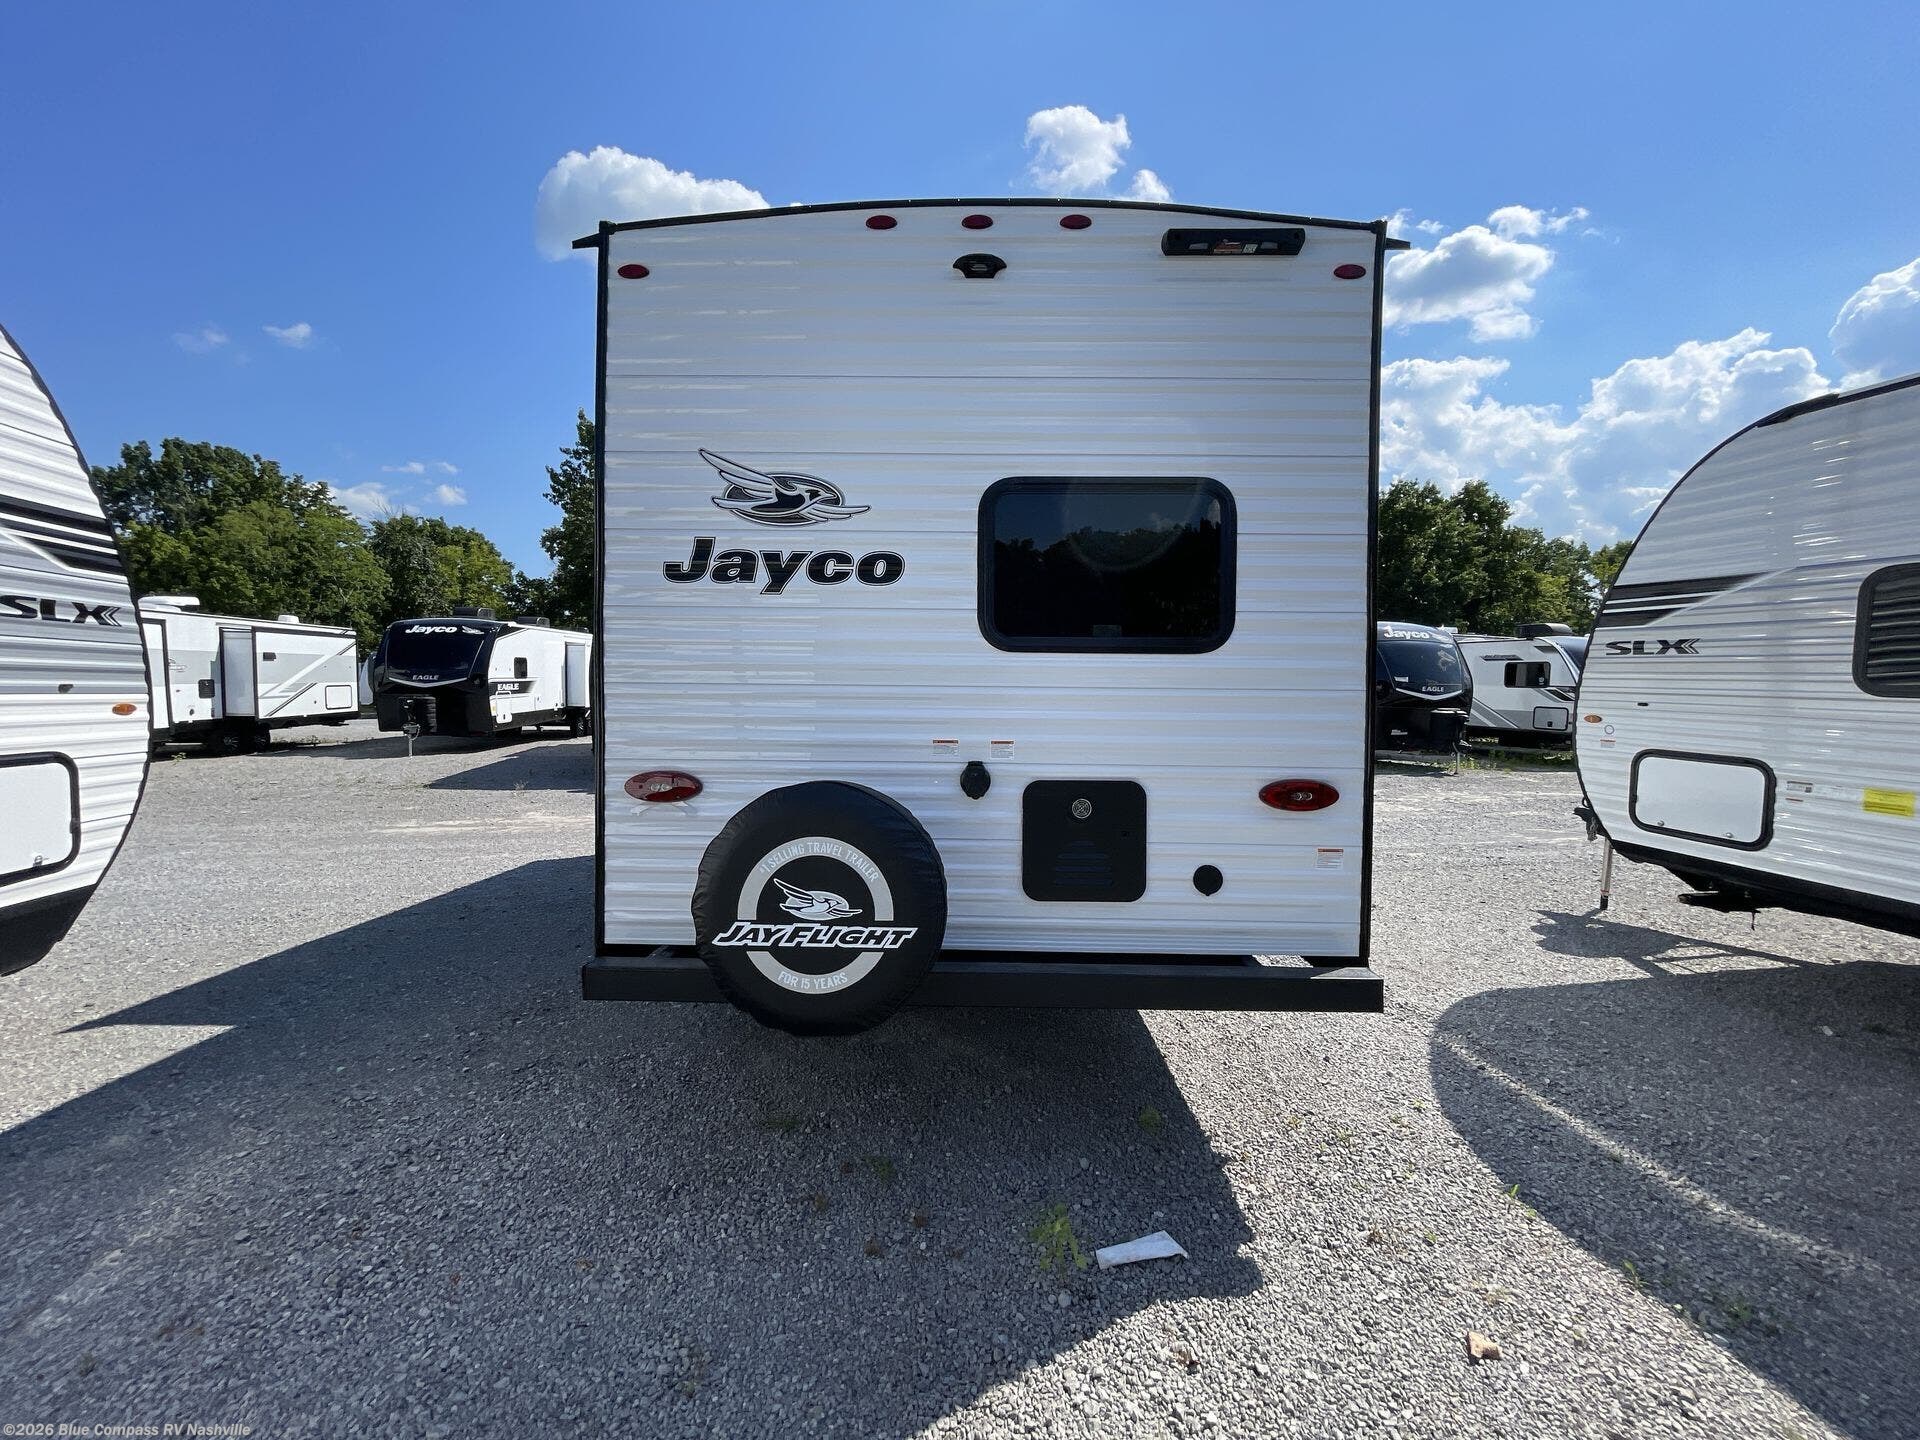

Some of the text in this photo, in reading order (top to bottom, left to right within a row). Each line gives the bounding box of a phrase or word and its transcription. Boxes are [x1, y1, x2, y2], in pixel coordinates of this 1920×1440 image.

[663, 536, 906, 595] Jayco
[0, 595, 122, 627] SLX
[405, 625, 458, 634] Jayco
[1383, 625, 1430, 639] Jayco
[1605, 638, 1701, 655] SLX
[497, 683, 520, 691] EAGLE
[770, 843, 805, 869] SELLING
[807, 841, 842, 857] TRAVEL
[845, 849, 879, 882] TRAILER
[778, 971, 848, 990] FOR 15 YEARS
